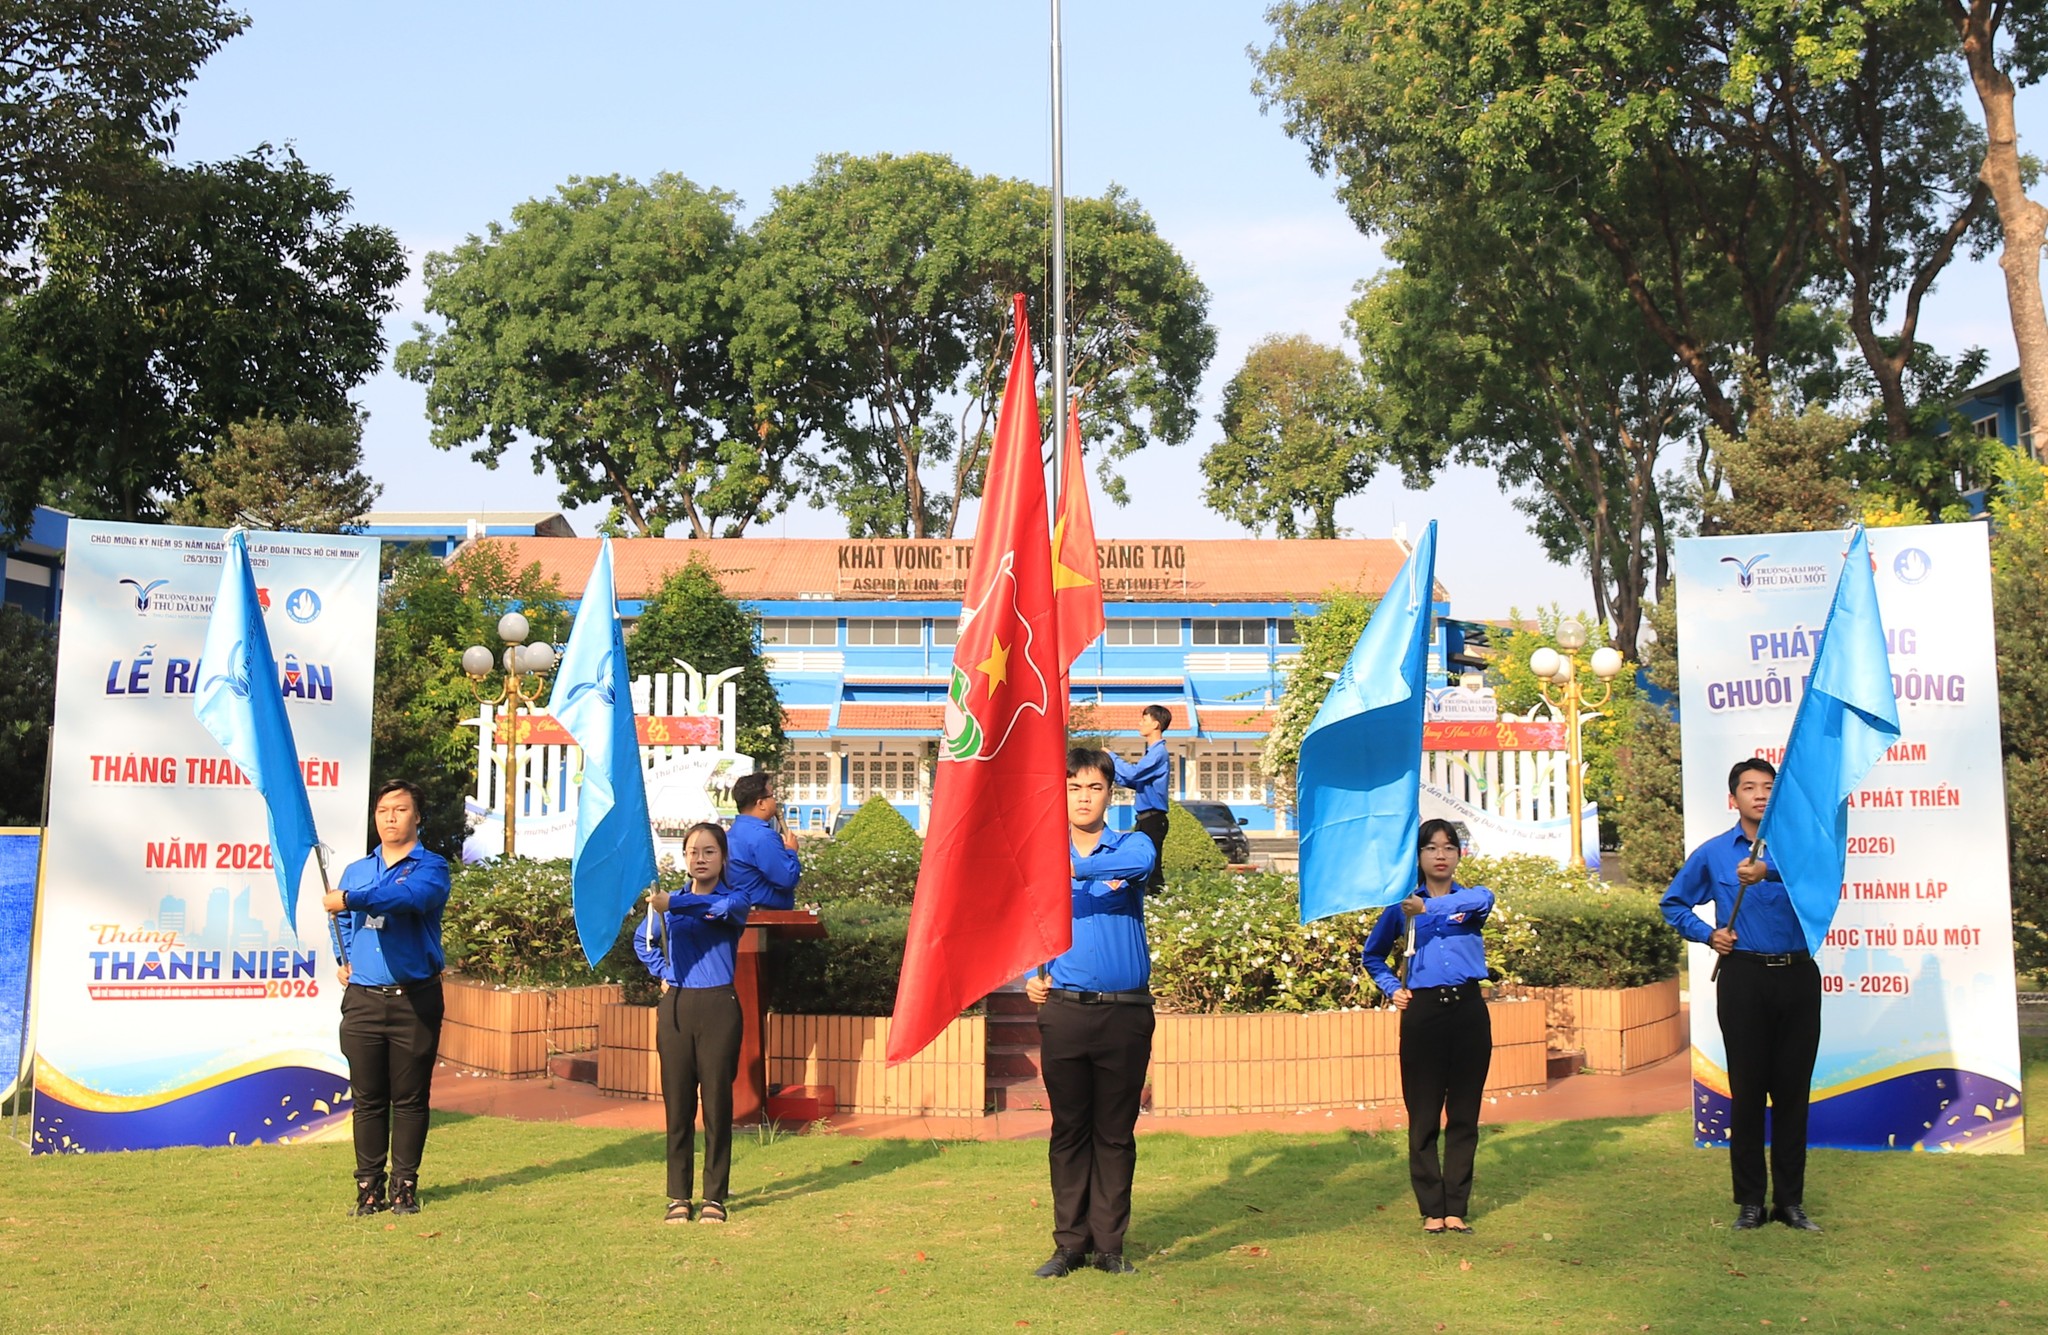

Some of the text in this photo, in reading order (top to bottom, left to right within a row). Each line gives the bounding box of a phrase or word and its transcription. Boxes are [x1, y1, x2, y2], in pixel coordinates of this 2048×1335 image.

[173, 538, 183, 548] 95
[293, 546, 312, 556] TNCS
[340, 549, 360, 558] MINH
[1152, 545, 1185, 575] TẠO
[853, 578, 938, 590] ASPIRAION
[1101, 578, 1170, 590] REATIVITY
[106, 644, 157, 694] LỄ
[277, 653, 333, 700] ÂN
[1707, 668, 1792, 710] CHUỖI
[1887, 742, 1926, 762] NĂM
[90, 753, 177, 784] THÁNG
[299, 757, 339, 787] IÊN
[1860, 786, 1903, 808] PHÁT
[1909, 782, 1960, 807] TRIỂN
[146, 837, 274, 869] NĂM 2026
[1853, 879, 1909, 900] THÀNH
[1916, 878, 1948, 903] LẬP
[89, 924, 185, 953] Tháng
[1825, 923, 1980, 949] HỌC THỦ DẦU MỘT
[89, 946, 316, 980] THANH NIÊN
[266, 980, 319, 998] 2026
[1861, 976, 1909, 994] 2026)
